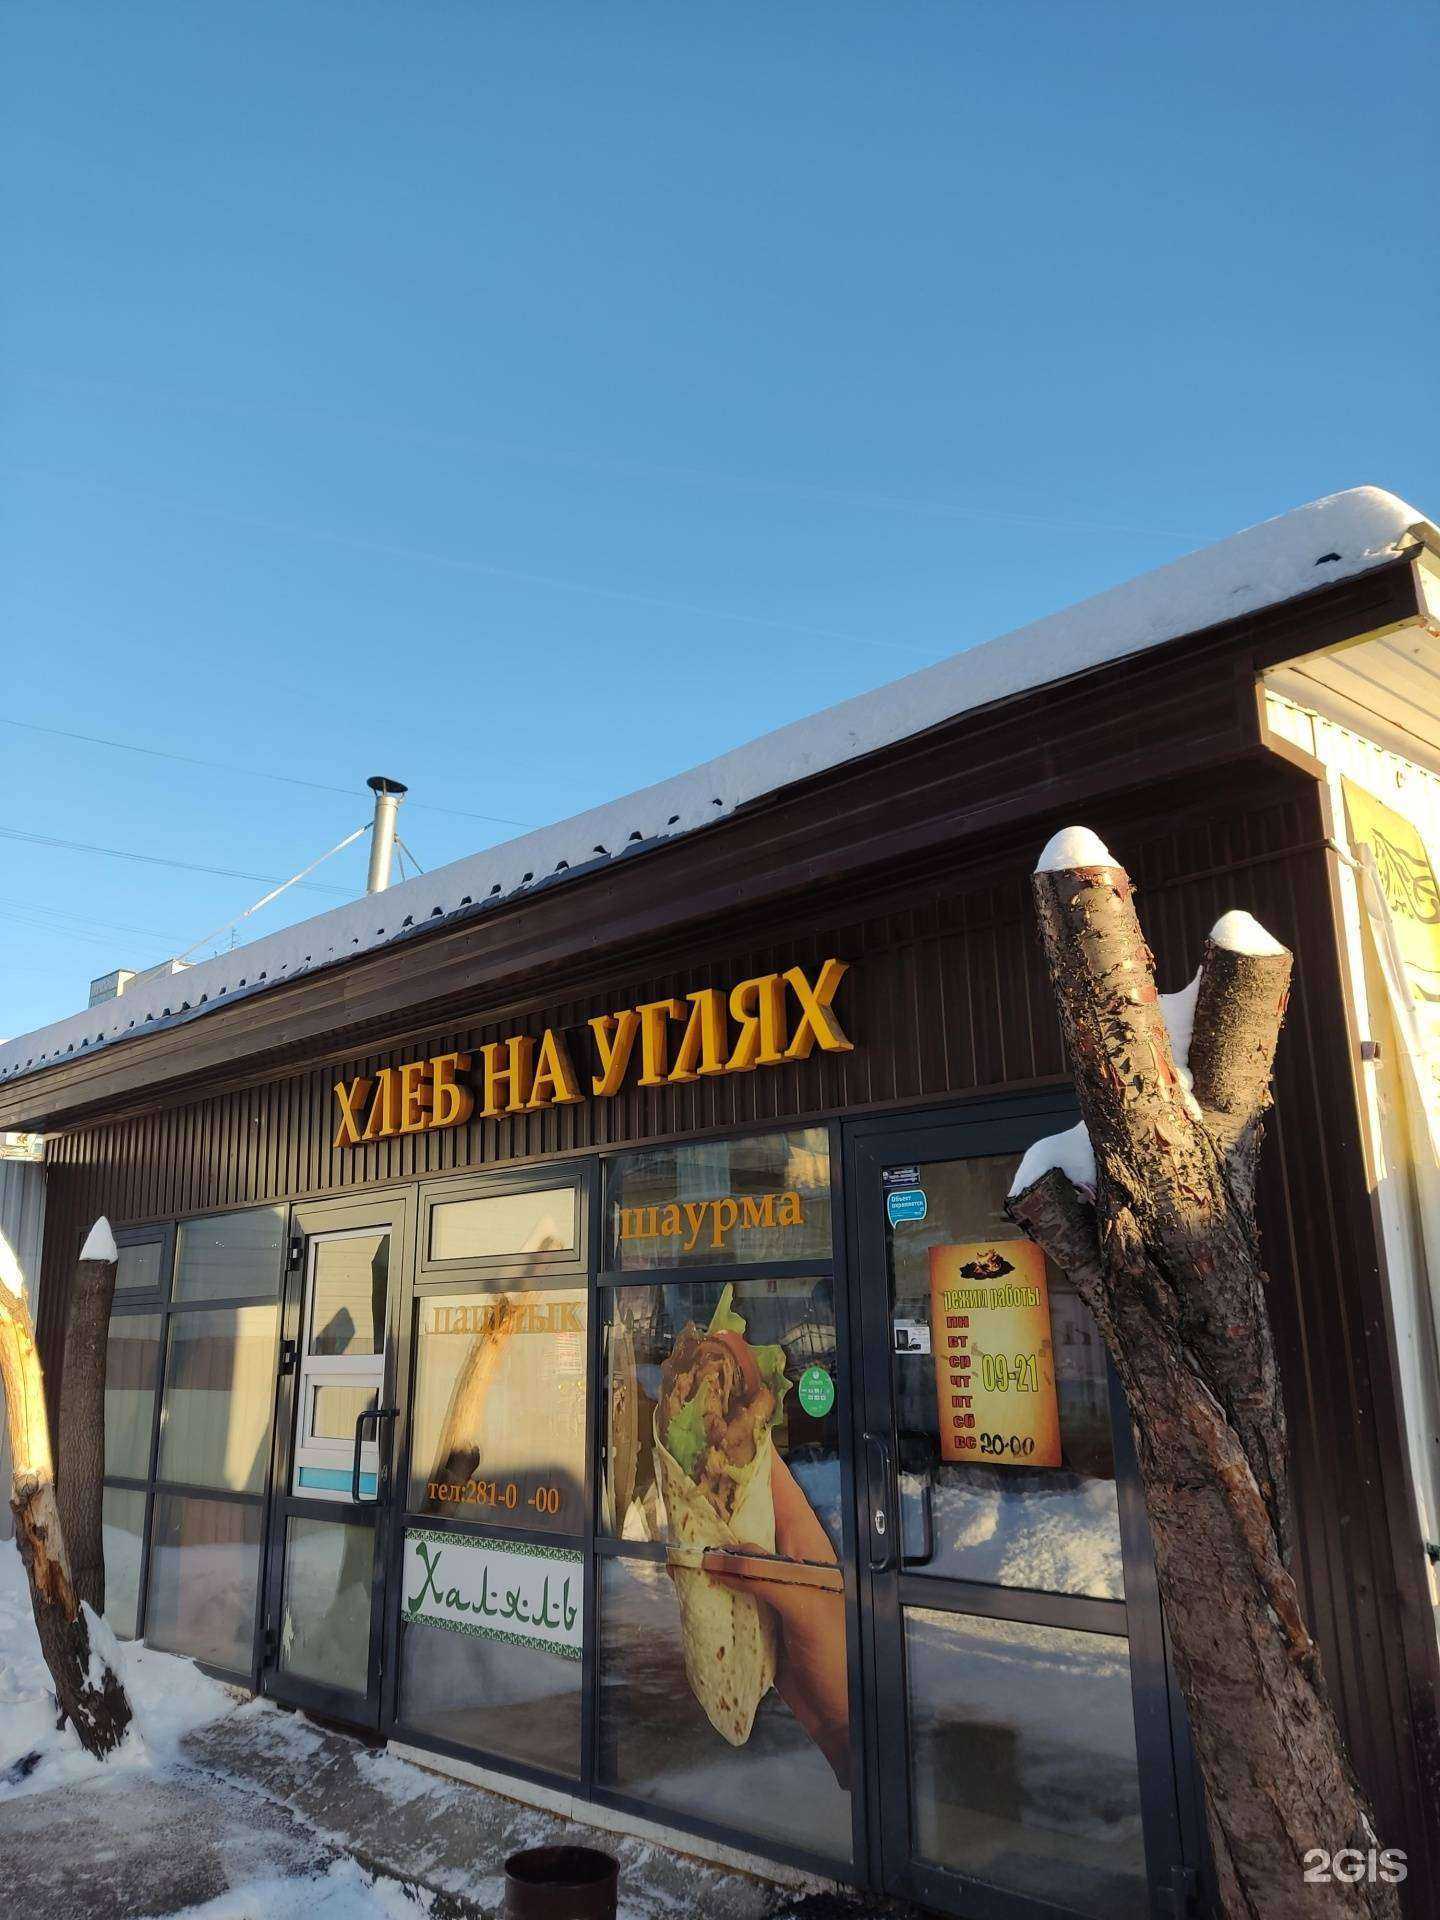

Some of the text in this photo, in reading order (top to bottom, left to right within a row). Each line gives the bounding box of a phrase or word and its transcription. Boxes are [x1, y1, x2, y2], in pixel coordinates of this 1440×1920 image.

[334, 958, 855, 1148] ХЛЕБ НА УГЛЯХ
[620, 1190, 804, 1251] шаурма
[944, 1283, 1041, 1312] режим работы
[949, 1355, 972, 1370] ср
[981, 1353, 1040, 1393] 09-21
[953, 1413, 976, 1429] сб
[408, 1541, 579, 1632] Халяль
